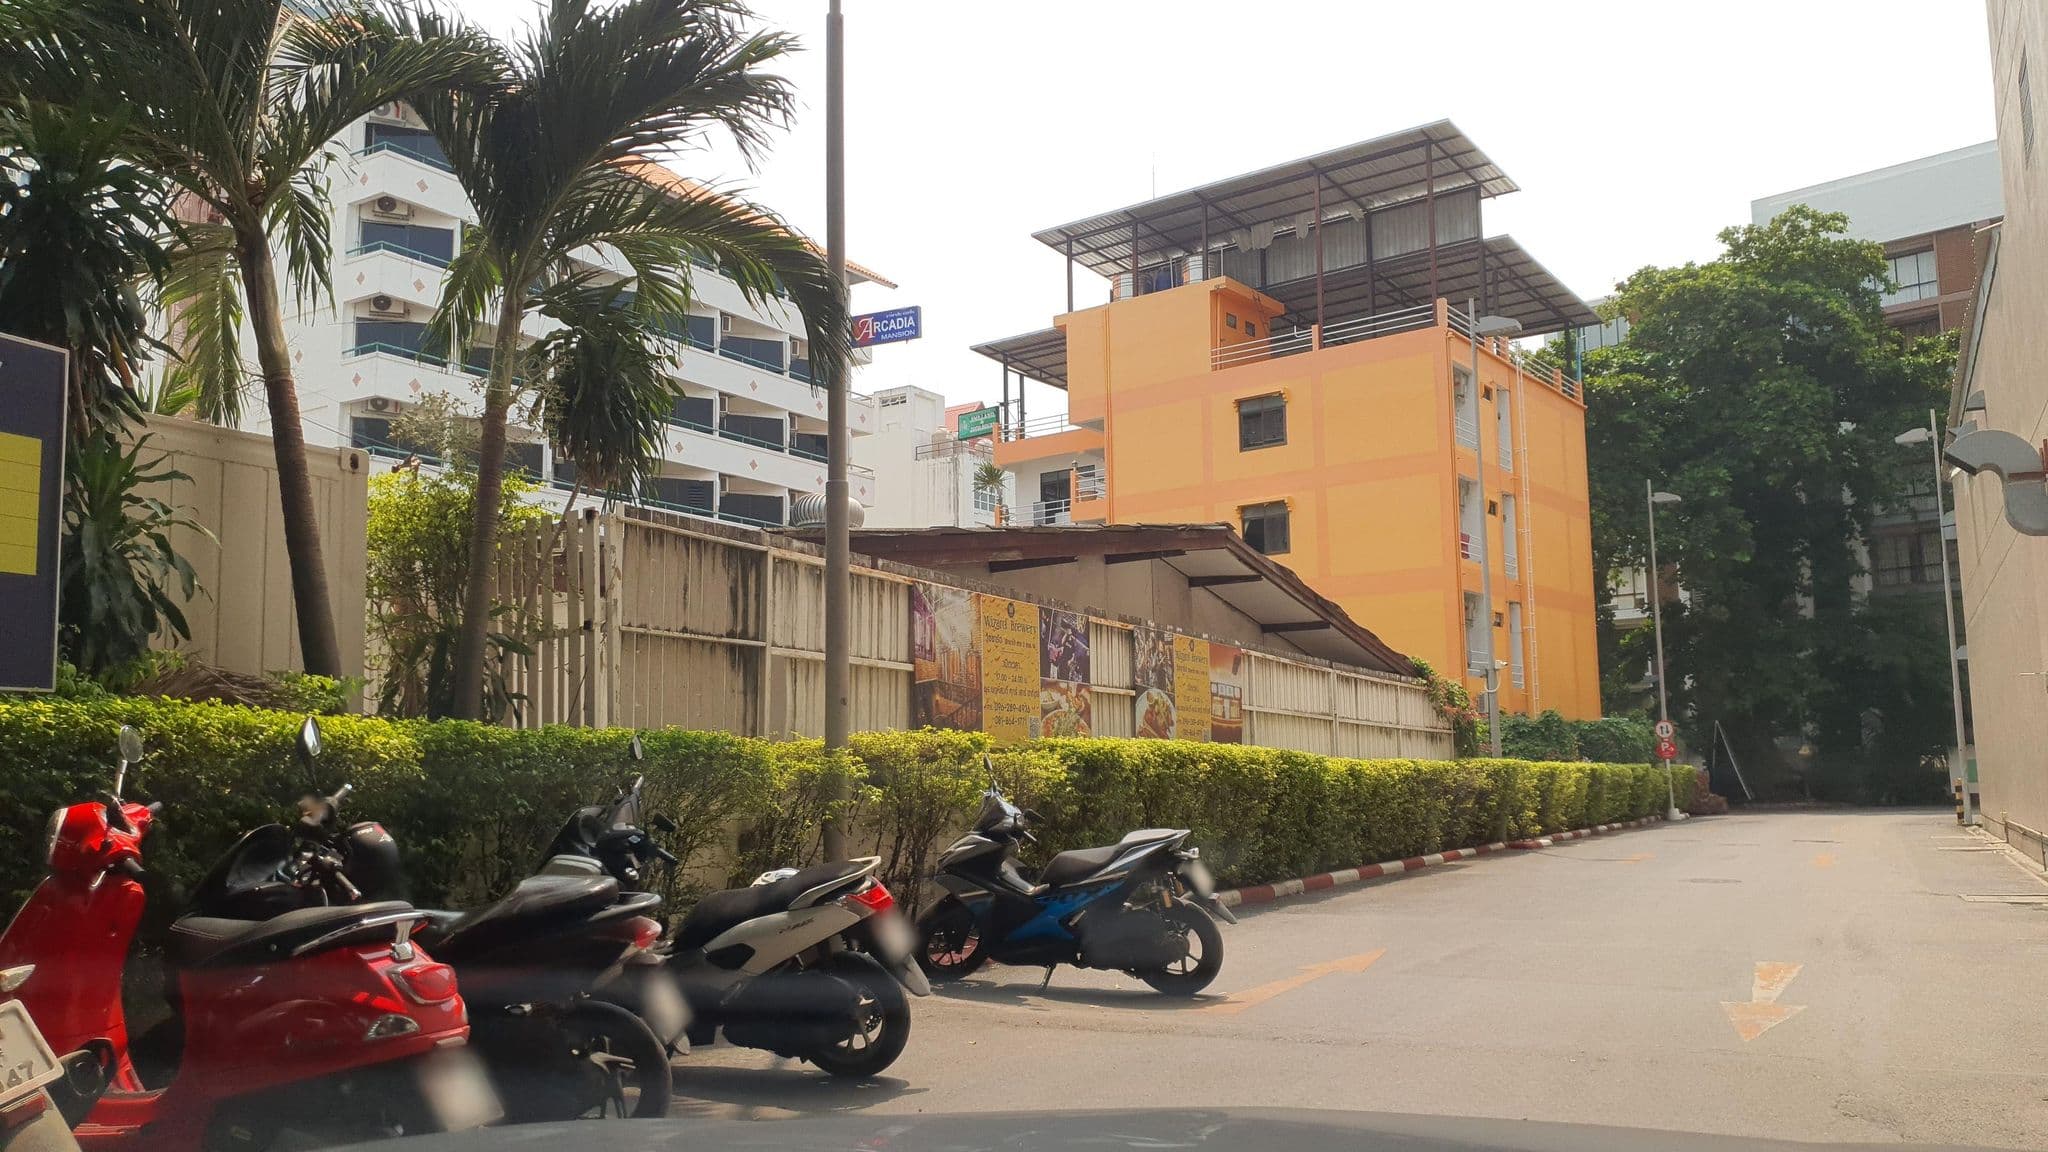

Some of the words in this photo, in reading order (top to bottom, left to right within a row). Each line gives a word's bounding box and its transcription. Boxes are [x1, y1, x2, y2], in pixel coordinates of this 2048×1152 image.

[855, 316, 915, 341] ARCADIA
[881, 329, 915, 341] MANSION
[1661, 742, 1670, 751] P
